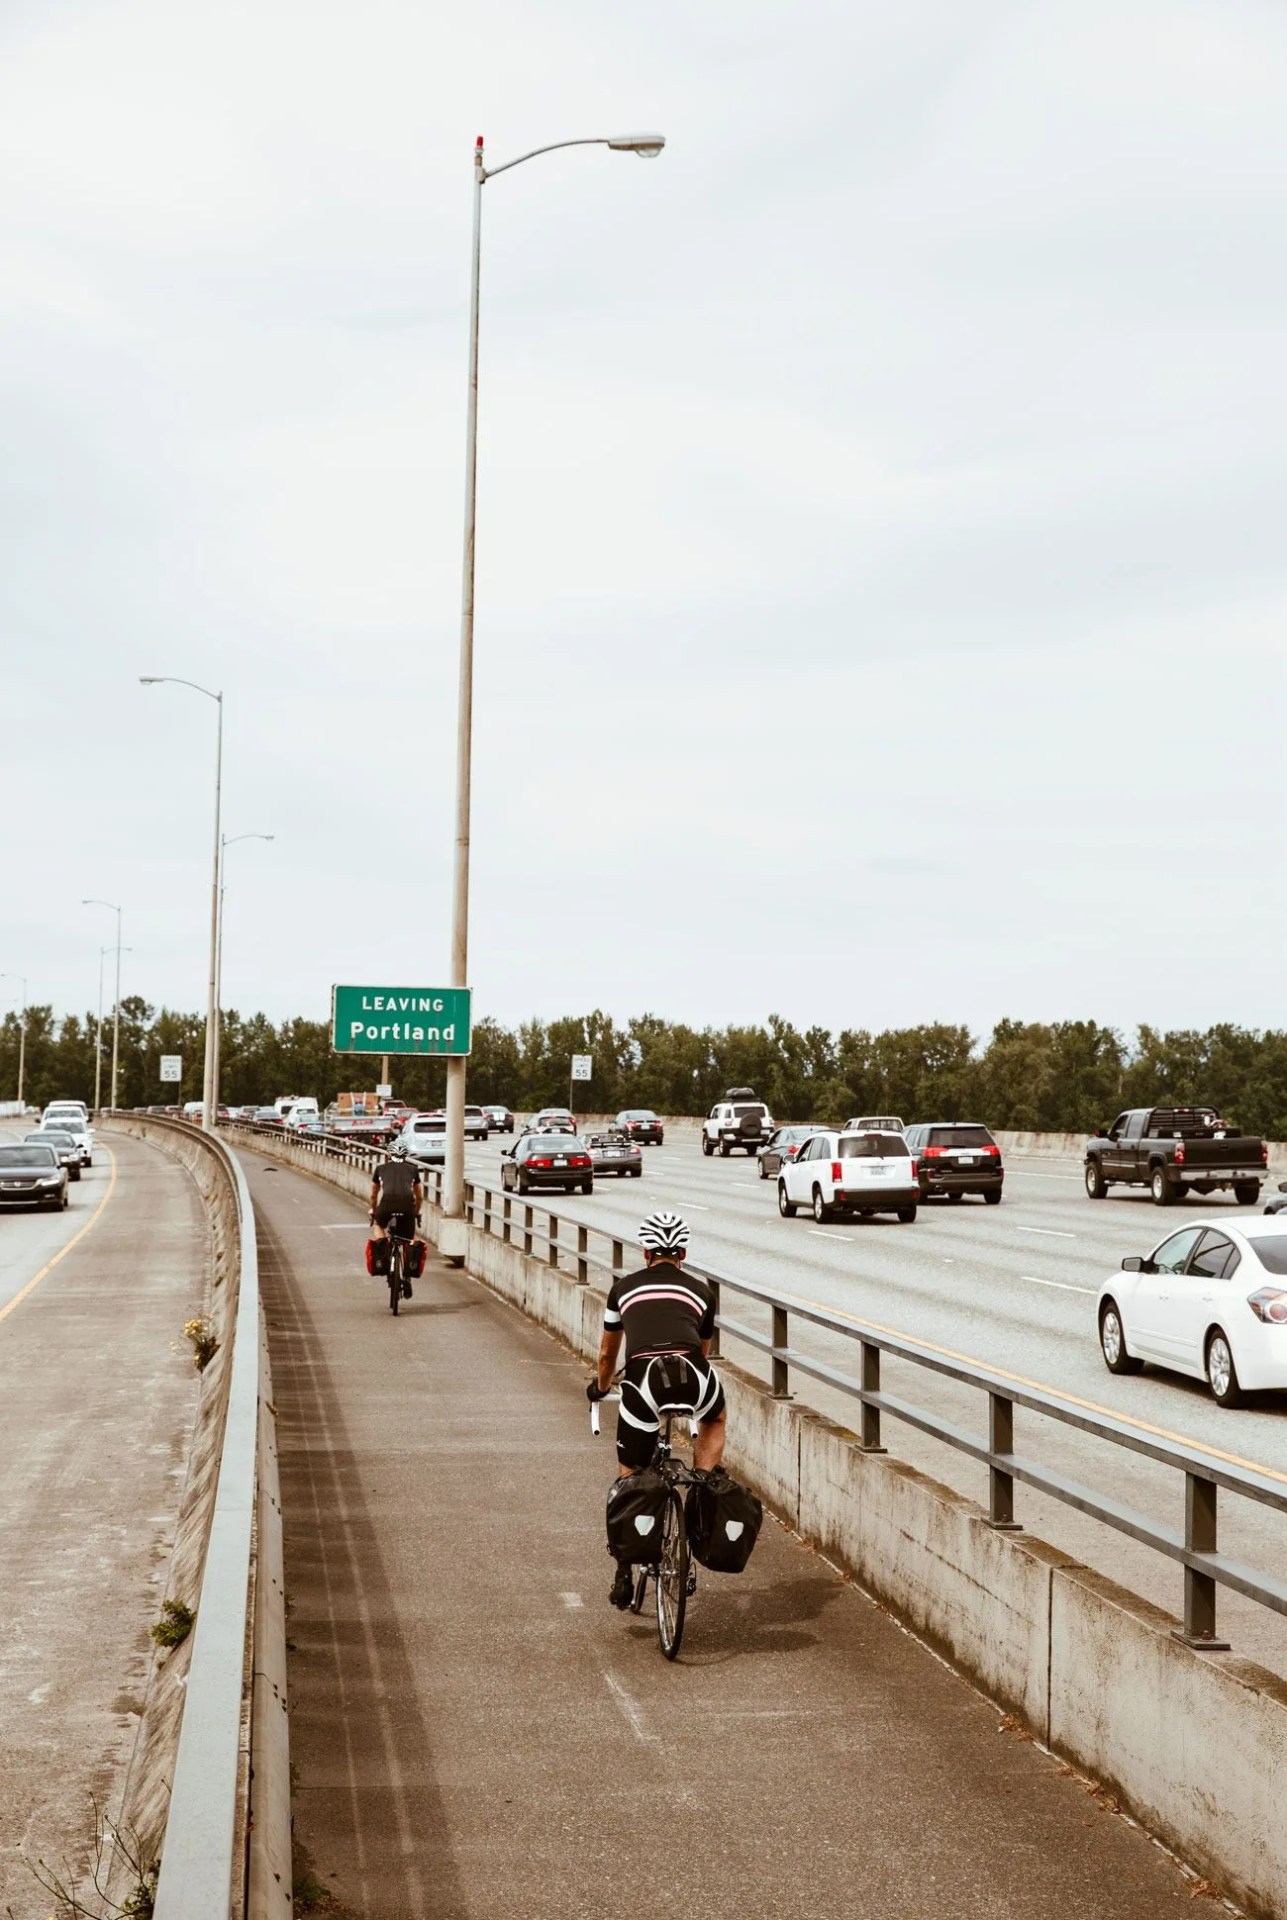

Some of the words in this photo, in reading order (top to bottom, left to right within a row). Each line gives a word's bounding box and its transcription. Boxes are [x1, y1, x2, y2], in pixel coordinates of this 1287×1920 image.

[362, 996, 444, 1012] LEAVING
[350, 1021, 455, 1041] Portland
[164, 1070, 178, 1079] 55
[576, 1069, 588, 1078] 55
